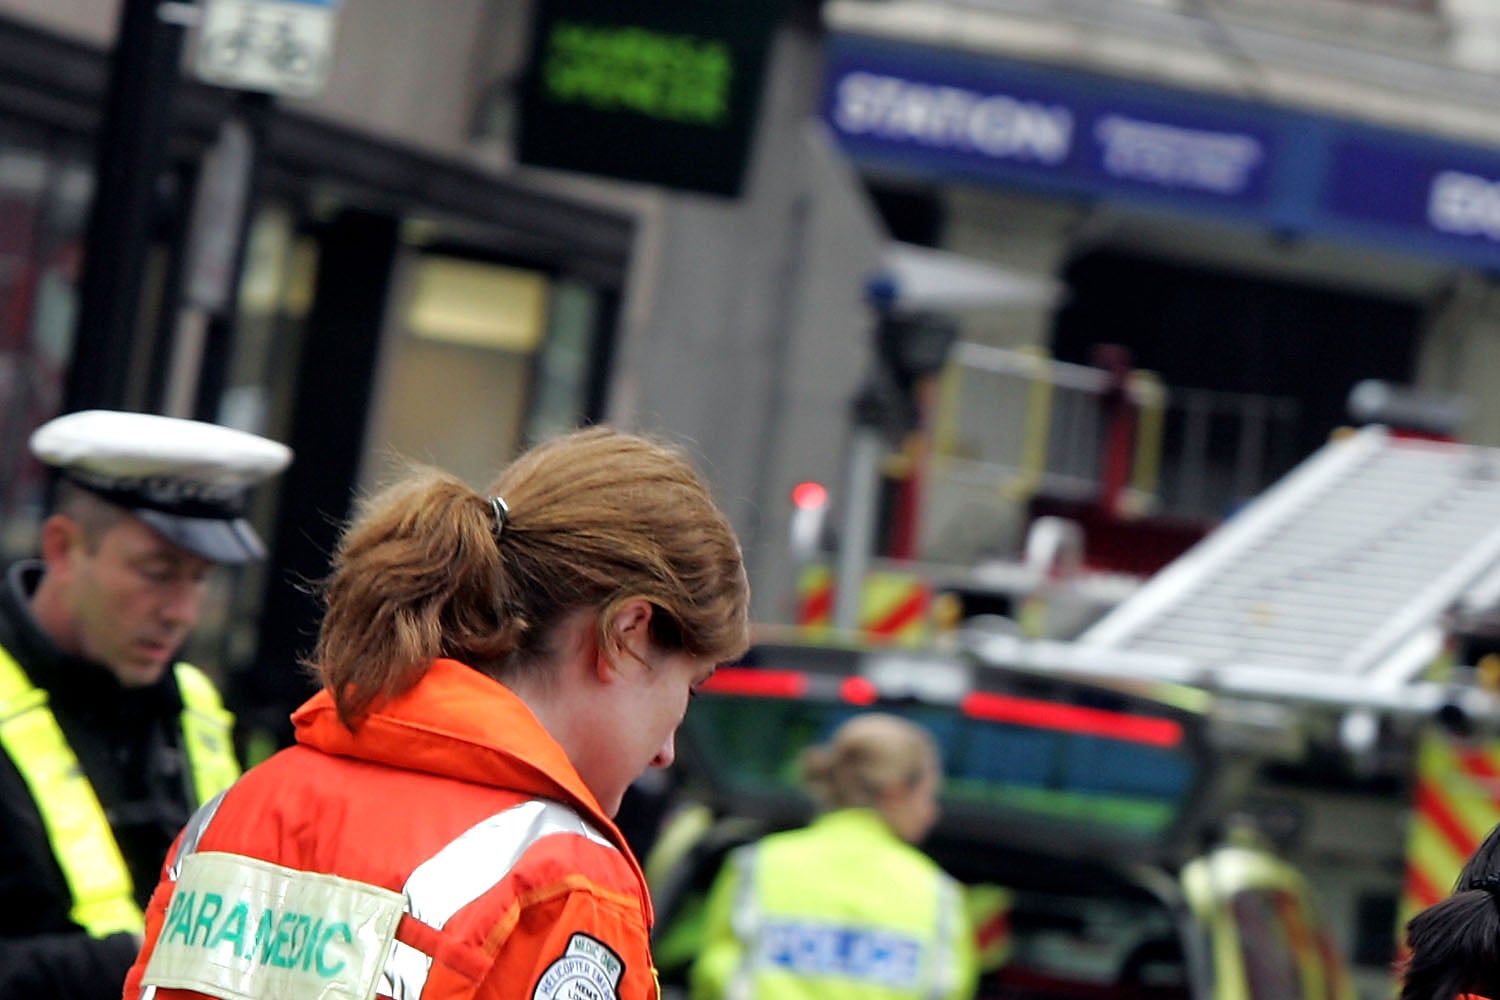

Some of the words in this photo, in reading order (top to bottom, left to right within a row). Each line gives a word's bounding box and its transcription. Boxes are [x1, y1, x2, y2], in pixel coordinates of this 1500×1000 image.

[835, 72, 1073, 165] STATION
[573, 937, 601, 960] MEDIC
[600, 952, 618, 977] ONE
[763, 922, 920, 984] POLICE
[539, 959, 591, 995] HELICOPTER
[575, 979, 599, 1000] HEMS
